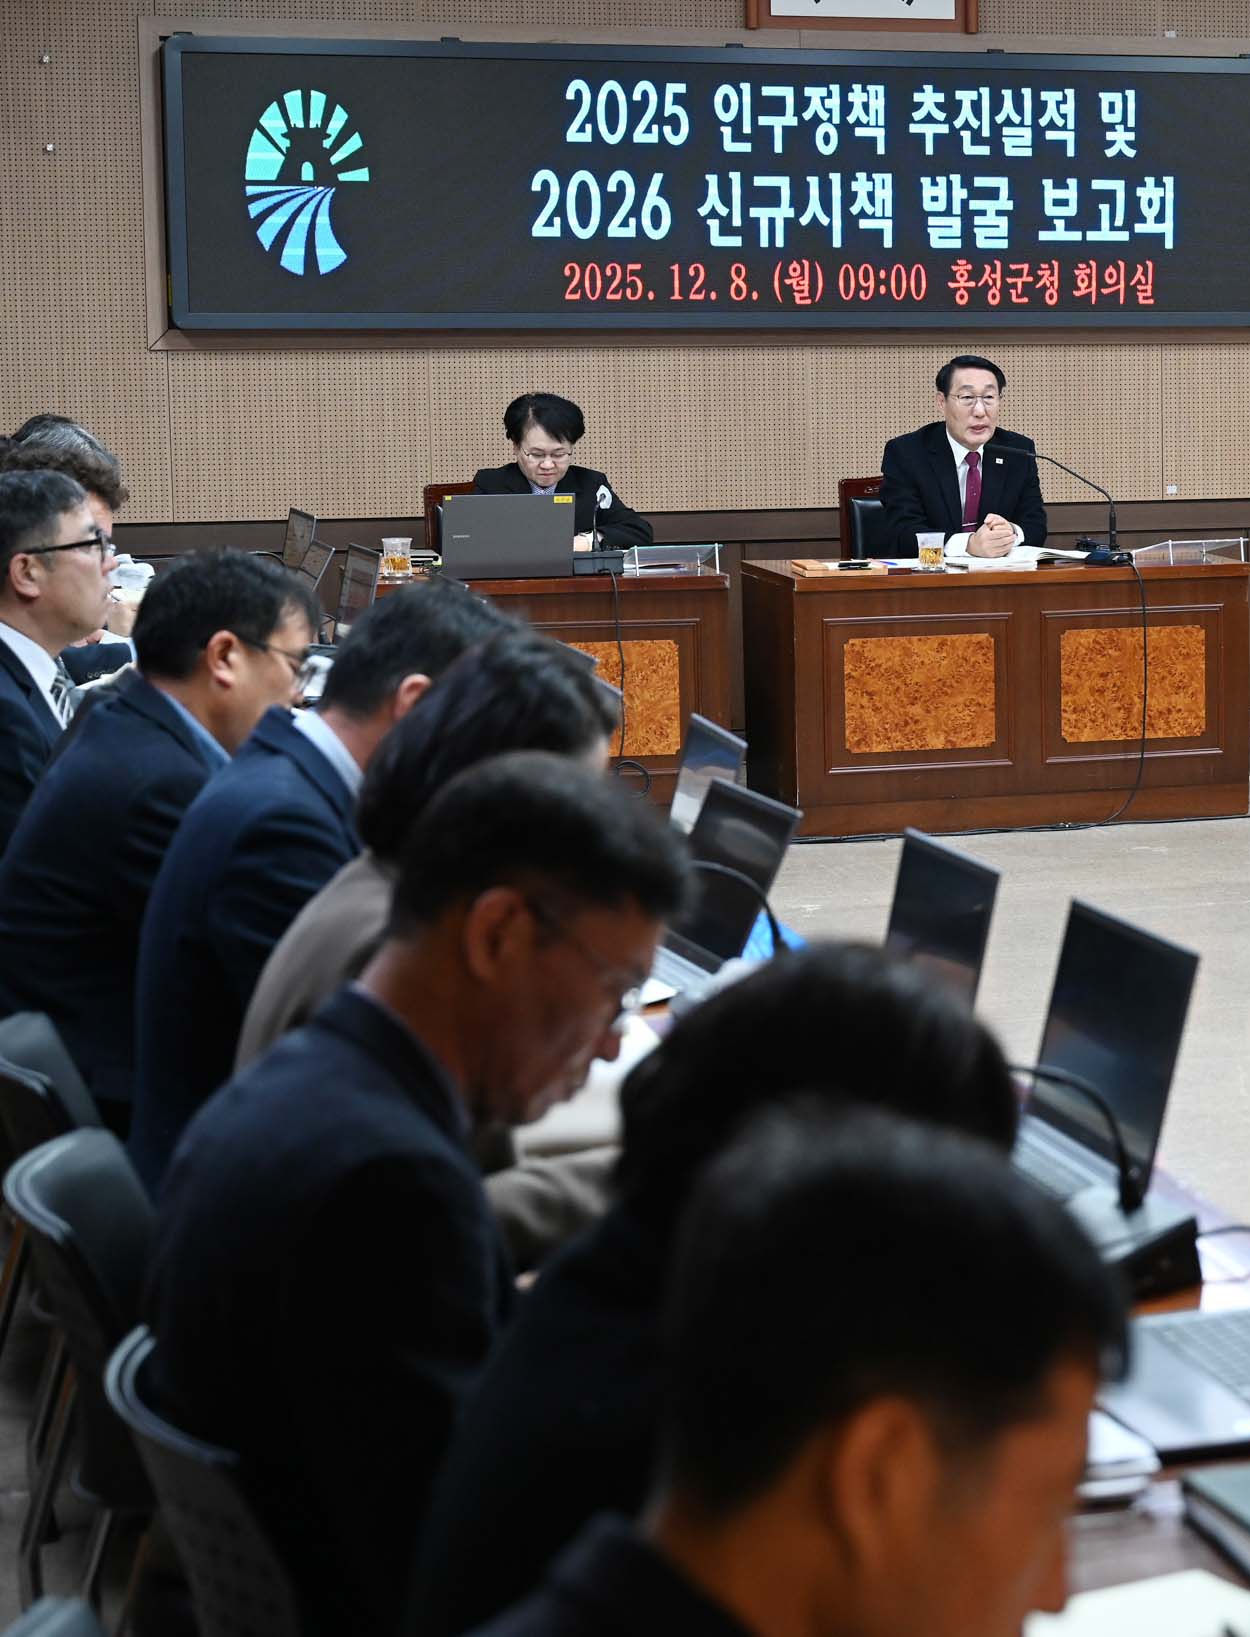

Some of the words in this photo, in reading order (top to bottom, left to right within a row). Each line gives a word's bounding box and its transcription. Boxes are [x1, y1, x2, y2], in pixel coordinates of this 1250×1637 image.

[565, 79, 690, 146] 2025
[713, 82, 886, 156] 인구정책
[908, 84, 1075, 158] 추진실적
[1098, 89, 1137, 159] 및
[531, 168, 672, 240] 2026
[697, 171, 893, 249] 신규시책
[920, 174, 1014, 249] 발굴
[1038, 175, 1175, 250] 보고회
[563, 262, 656, 301] 2025.
[669, 262, 717, 301] 12.
[729, 262, 759, 301] 8.
[773, 259, 824, 305] (월)
[838, 262, 927, 301] 09:00
[948, 259, 1060, 306] 홍성군청
[1072, 259, 1155, 305] 회의실
